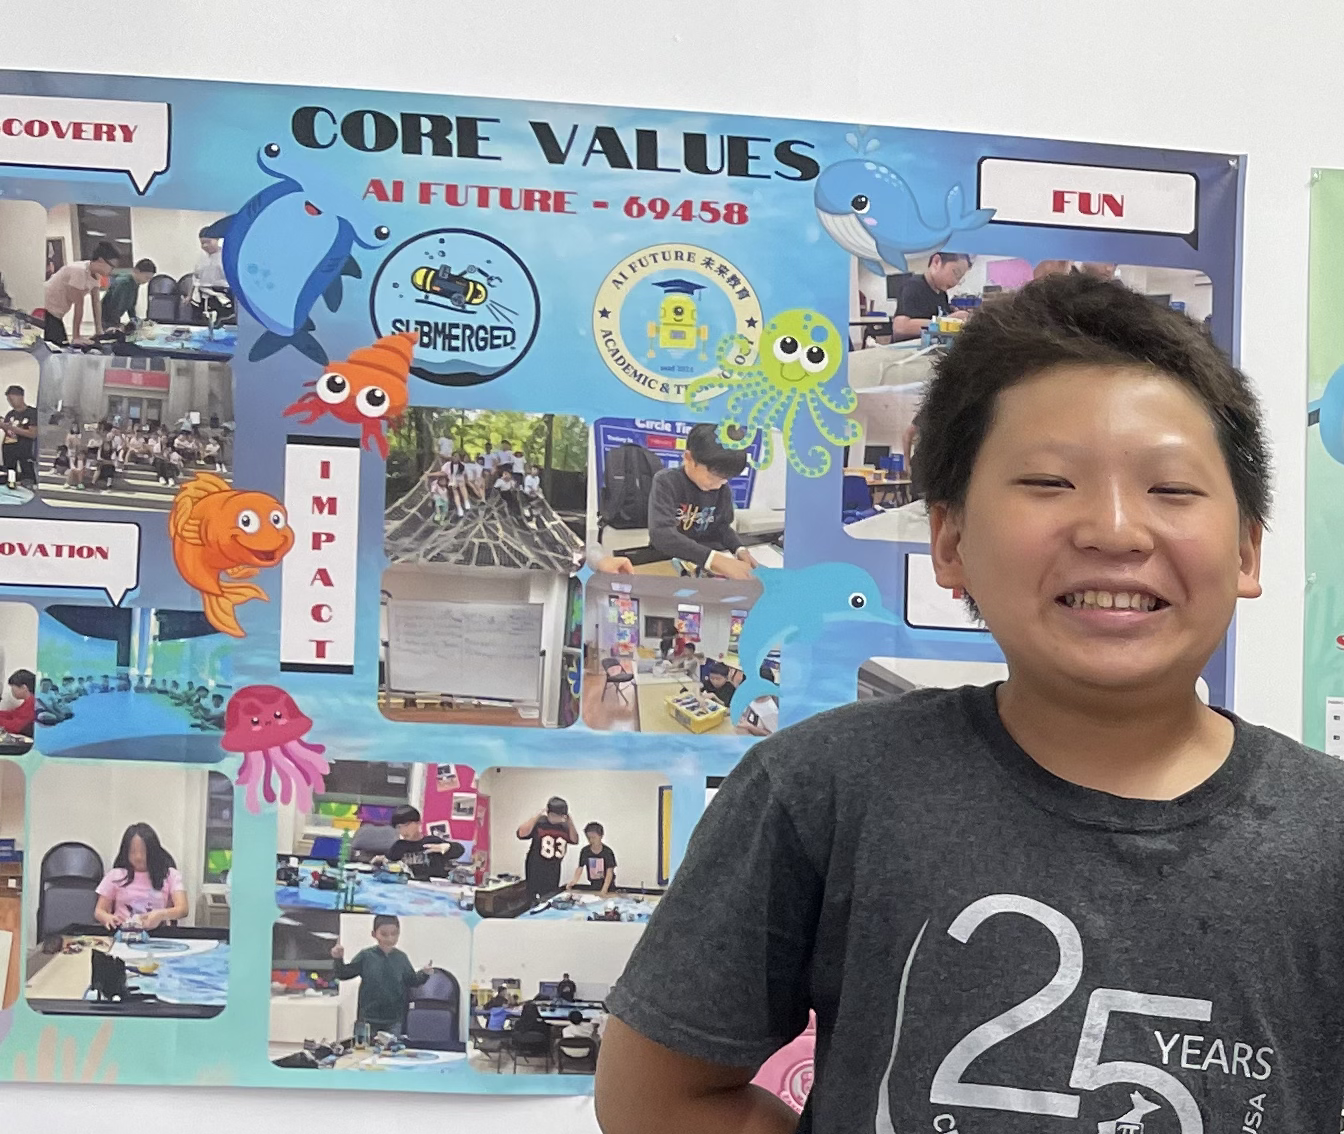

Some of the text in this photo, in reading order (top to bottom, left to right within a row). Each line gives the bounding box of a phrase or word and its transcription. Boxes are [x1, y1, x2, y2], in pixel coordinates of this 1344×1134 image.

[292, 106, 820, 181] CORE VALUES
[363, 179, 749, 225] AI FUTURE 69458
[1052, 190, 1125, 217] FUN
[628, 250, 697, 273] FUTURE
[601, 329, 658, 390] ACADEMIC
[308, 460, 338, 659] IMPACT
[538, 834, 567, 861] 83
[1154, 1030, 1274, 1081] YEARS
